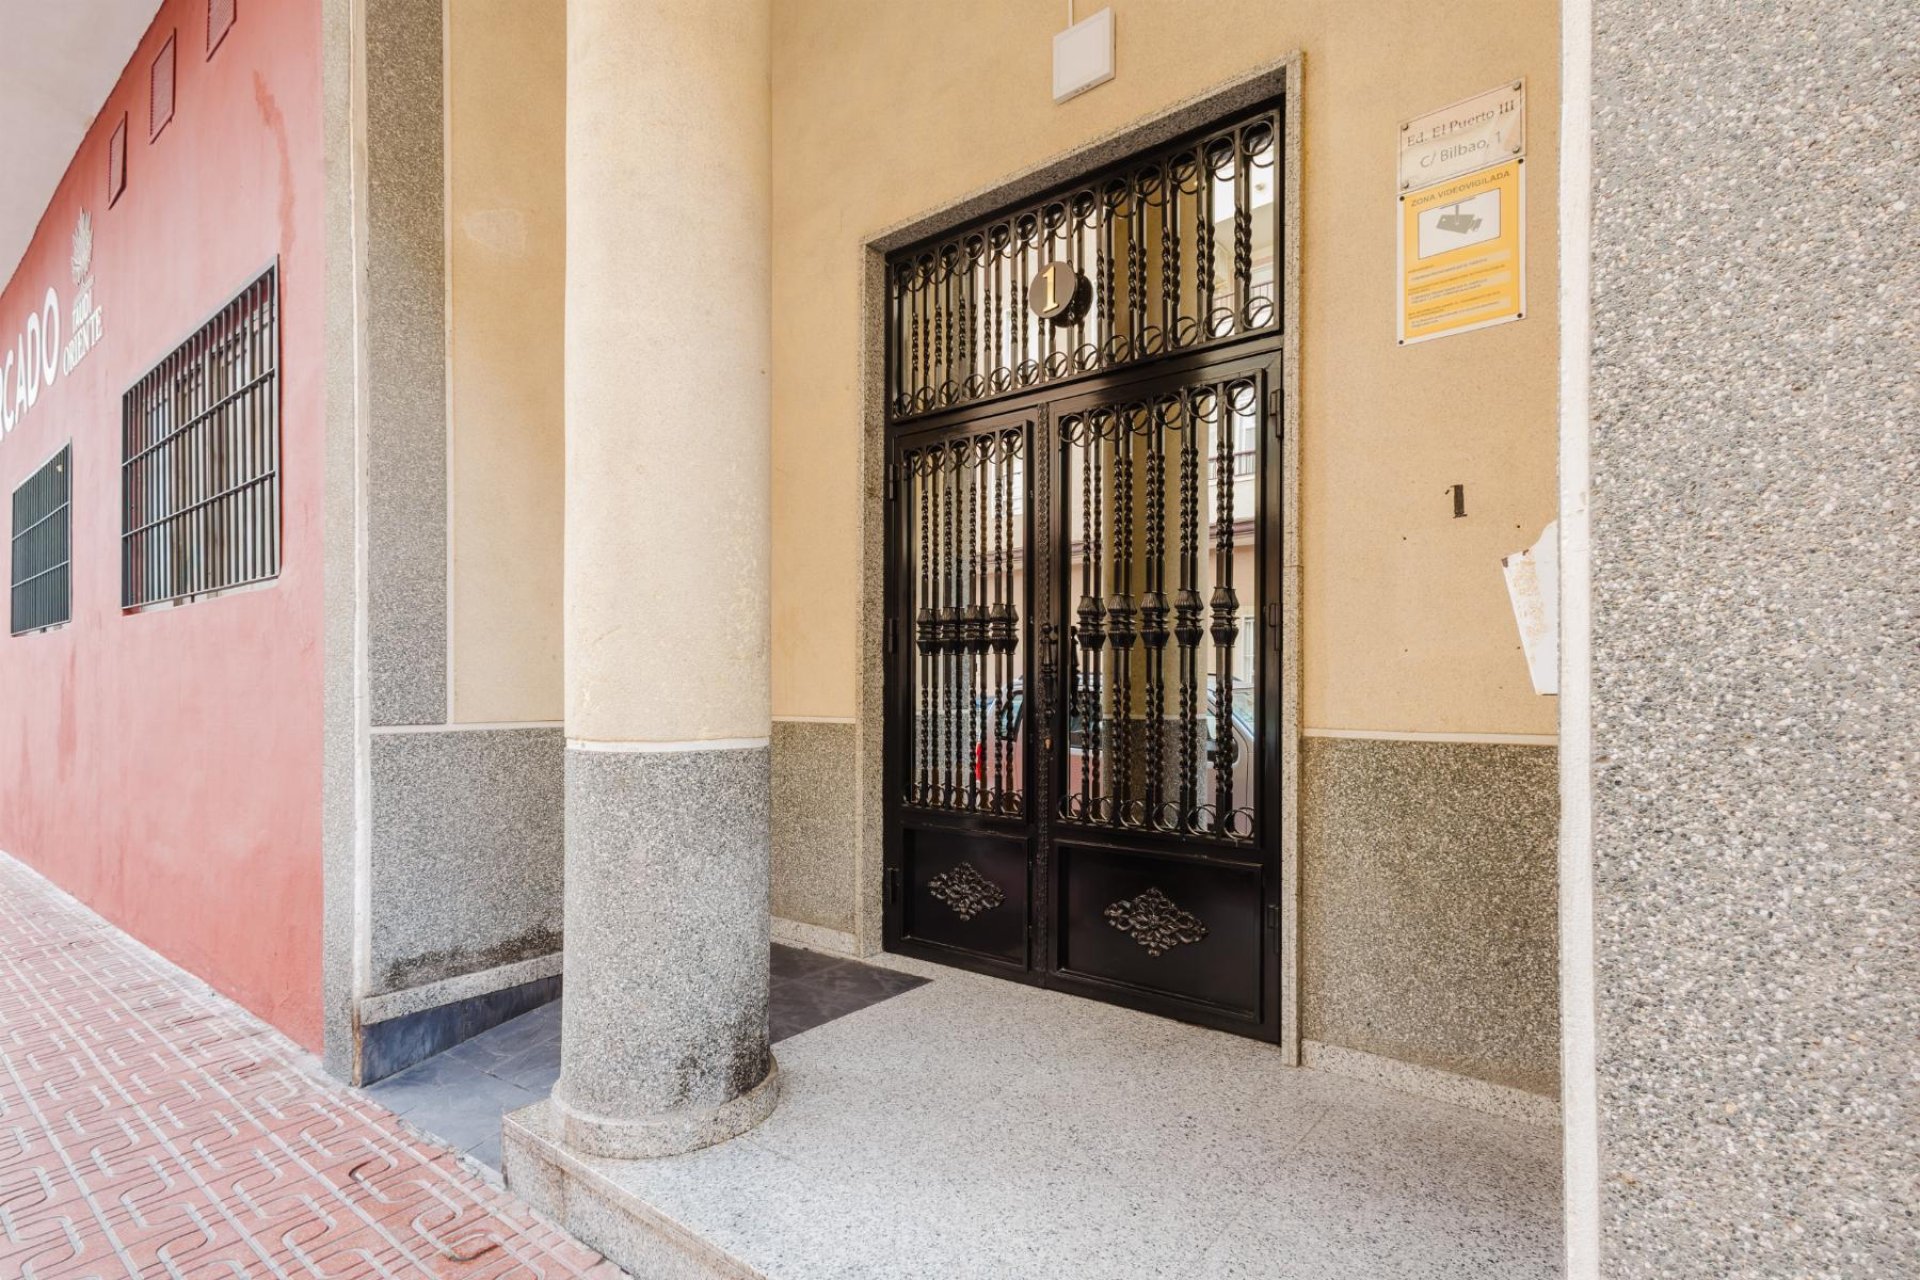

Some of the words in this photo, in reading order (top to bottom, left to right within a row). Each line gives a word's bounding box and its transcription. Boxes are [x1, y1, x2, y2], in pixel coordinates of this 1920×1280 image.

[1407, 132, 1428, 147] Ed.
[1449, 110, 1495, 132] Puerto
[1420, 150, 1436, 168] C/
[1440, 139, 1490, 162] Bilbao,
[1412, 194, 1436, 207] ZONA
[1438, 171, 1510, 197] VIDEOVIGILADA
[1042, 265, 1060, 313] 1
[0, 287, 60, 440] CADO
